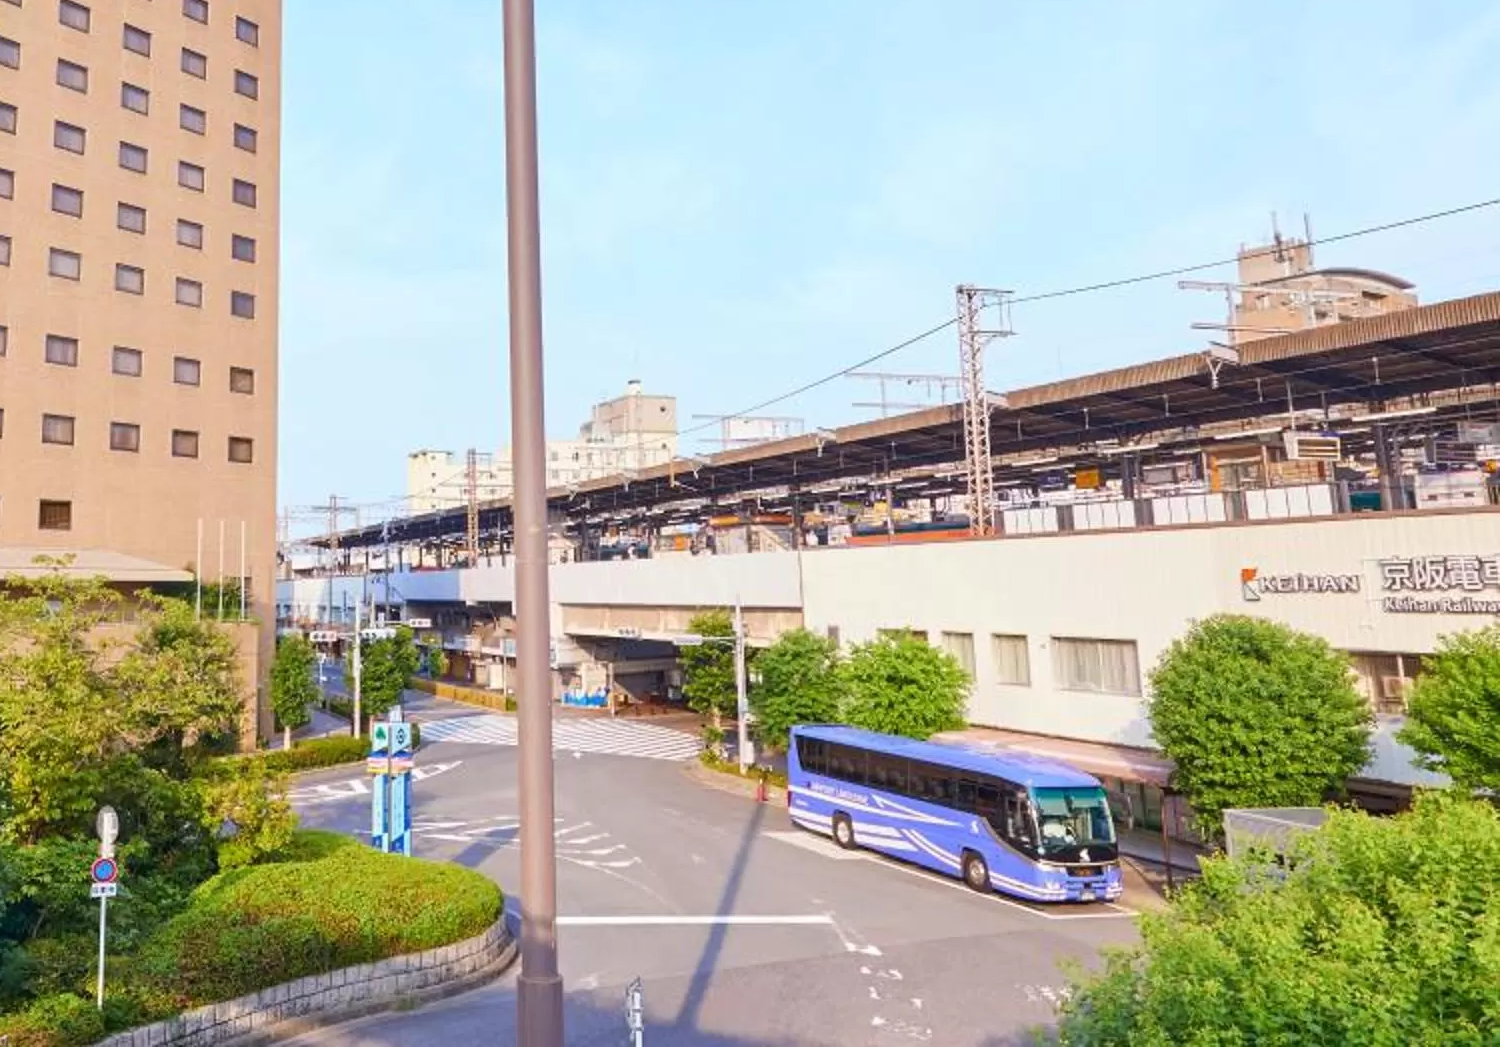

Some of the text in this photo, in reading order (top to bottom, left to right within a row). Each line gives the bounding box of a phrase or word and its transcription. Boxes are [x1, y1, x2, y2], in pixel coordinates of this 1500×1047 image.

[1260, 572, 1360, 594] KEIHAN
[1383, 596, 1500, 615] Keihan Railwa
